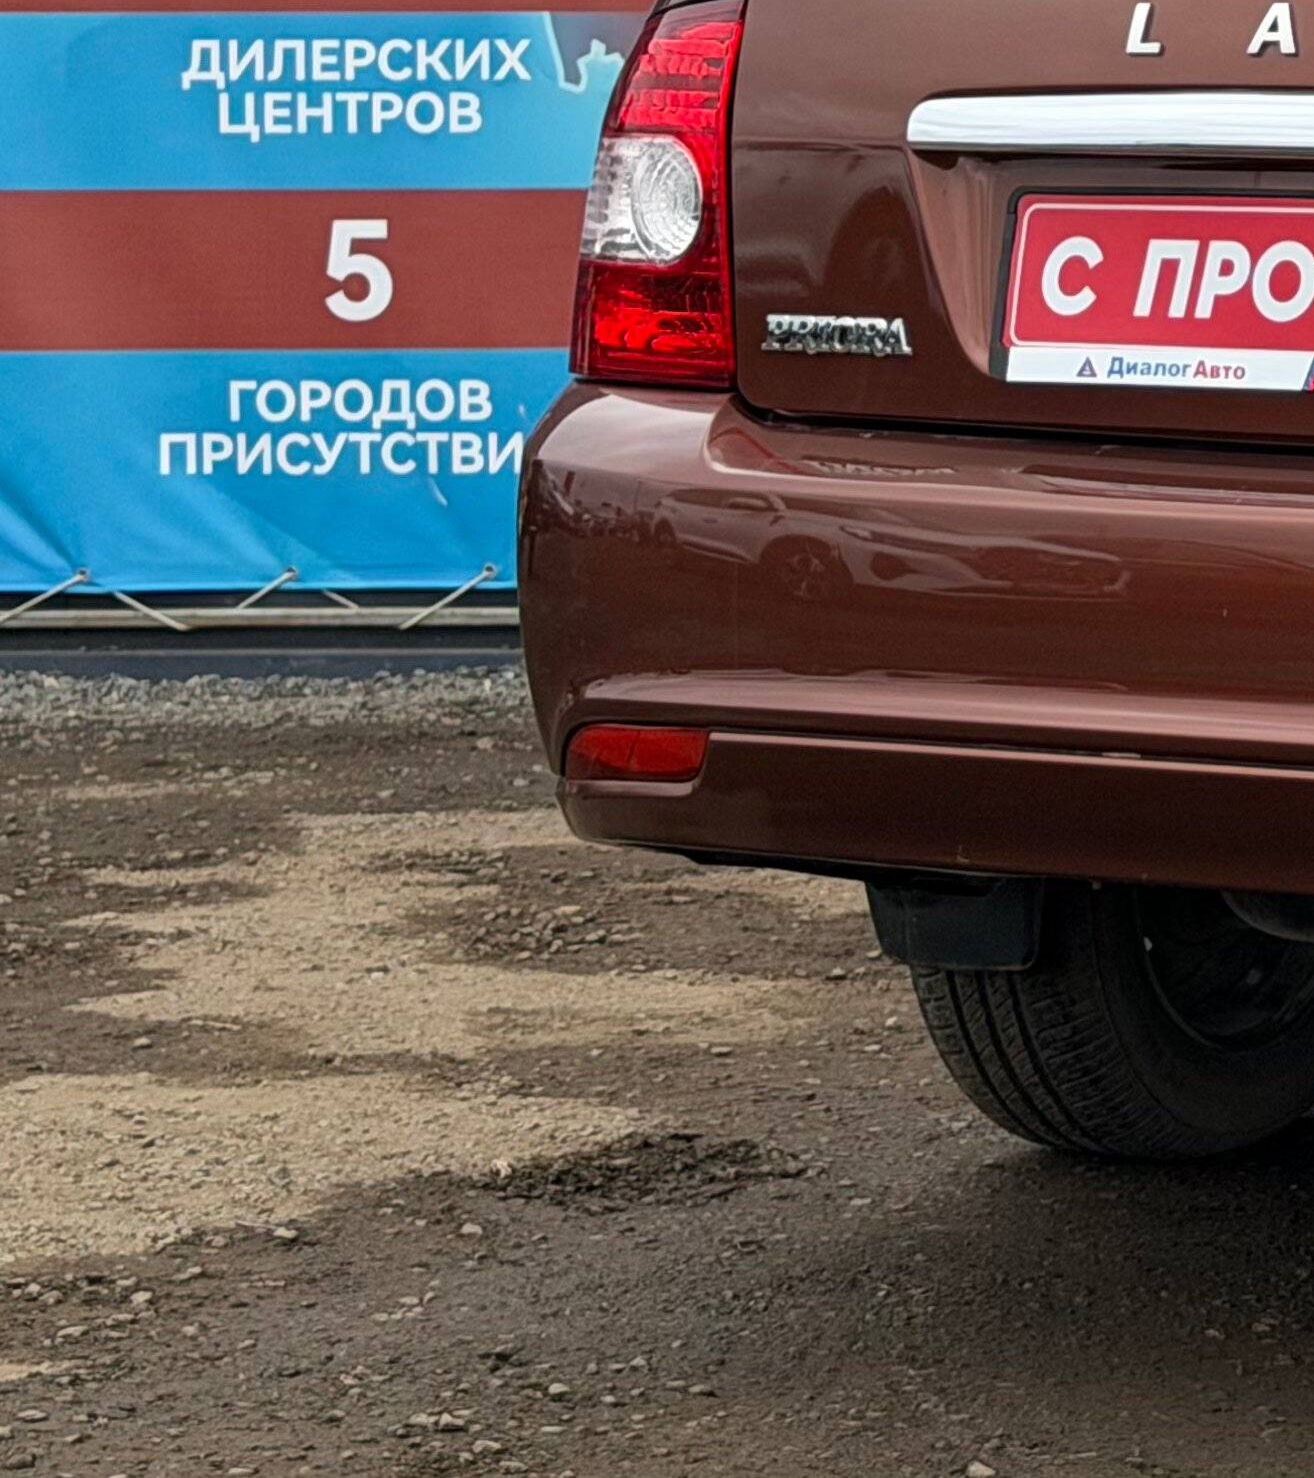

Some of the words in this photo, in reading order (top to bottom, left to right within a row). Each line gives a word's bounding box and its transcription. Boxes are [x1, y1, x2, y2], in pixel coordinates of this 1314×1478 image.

[181, 39, 532, 90] ДИЛЕРСКИХ
[218, 91, 483, 143] ЦЕНТРОВ
[324, 219, 394, 322] 5
[1041, 236, 1104, 317] С
[229, 379, 493, 430] ГОРОДОВ
[159, 432, 524, 475] ПРИСУТСТВИ
